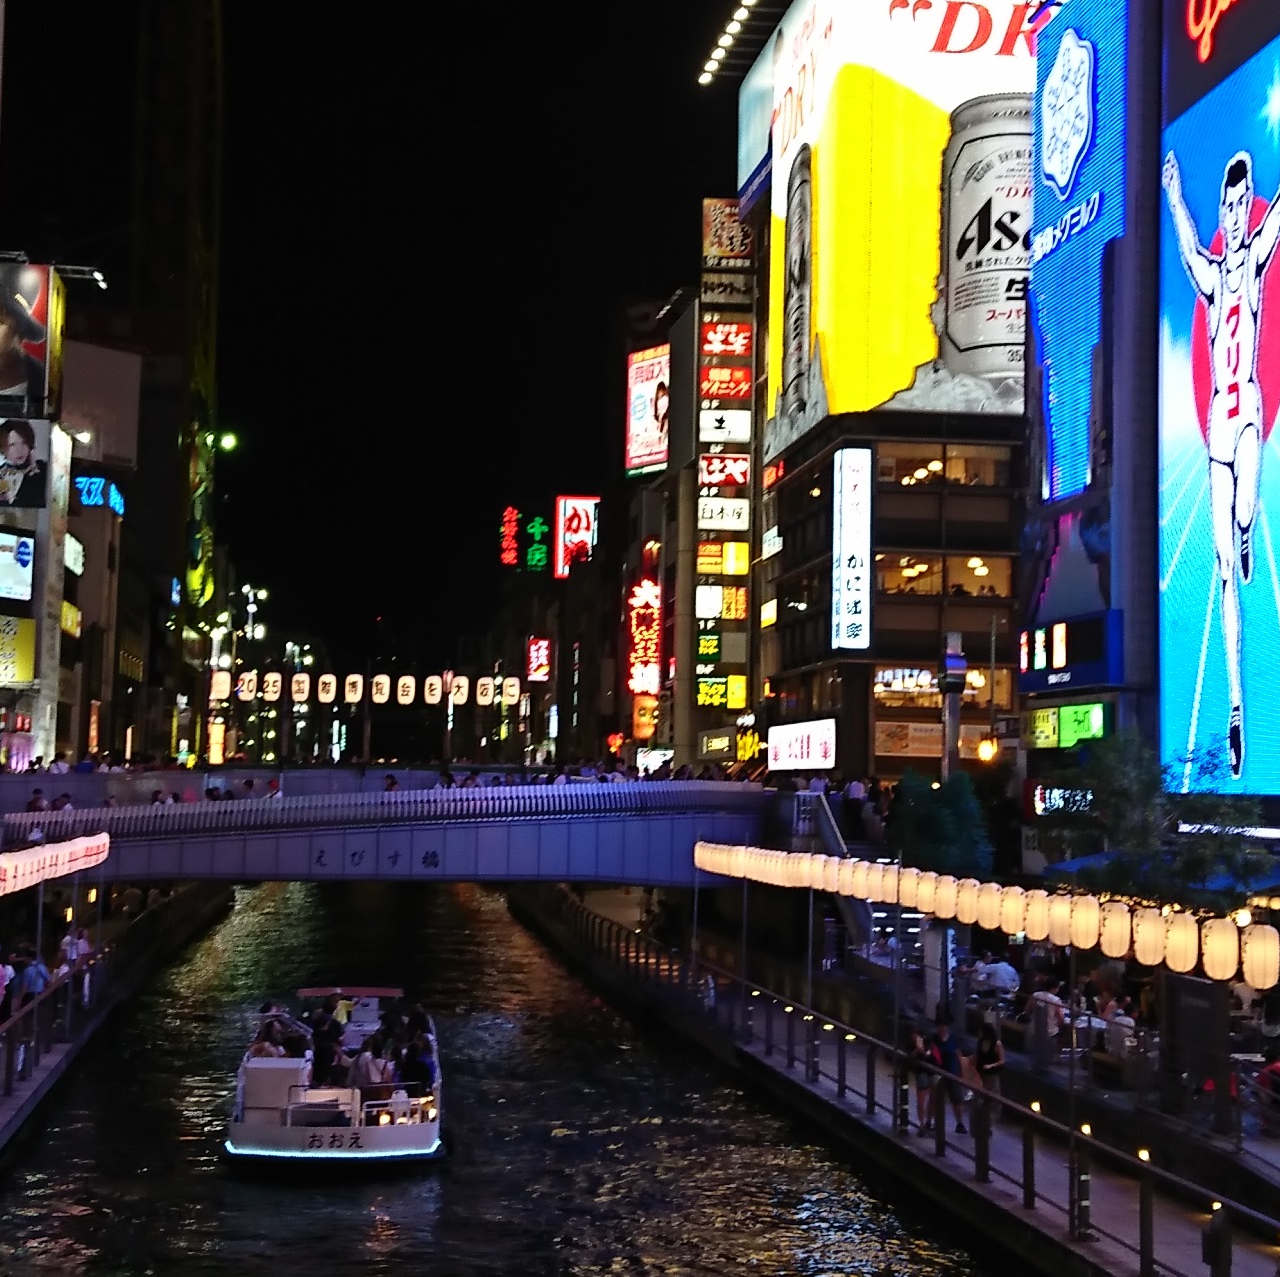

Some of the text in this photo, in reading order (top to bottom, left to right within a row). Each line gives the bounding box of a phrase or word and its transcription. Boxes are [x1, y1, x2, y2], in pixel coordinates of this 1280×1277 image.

[1223, 295, 1244, 421] グリコ
[701, 502, 744, 520] 白木屋
[308, 1132, 365, 1149] おおえ
